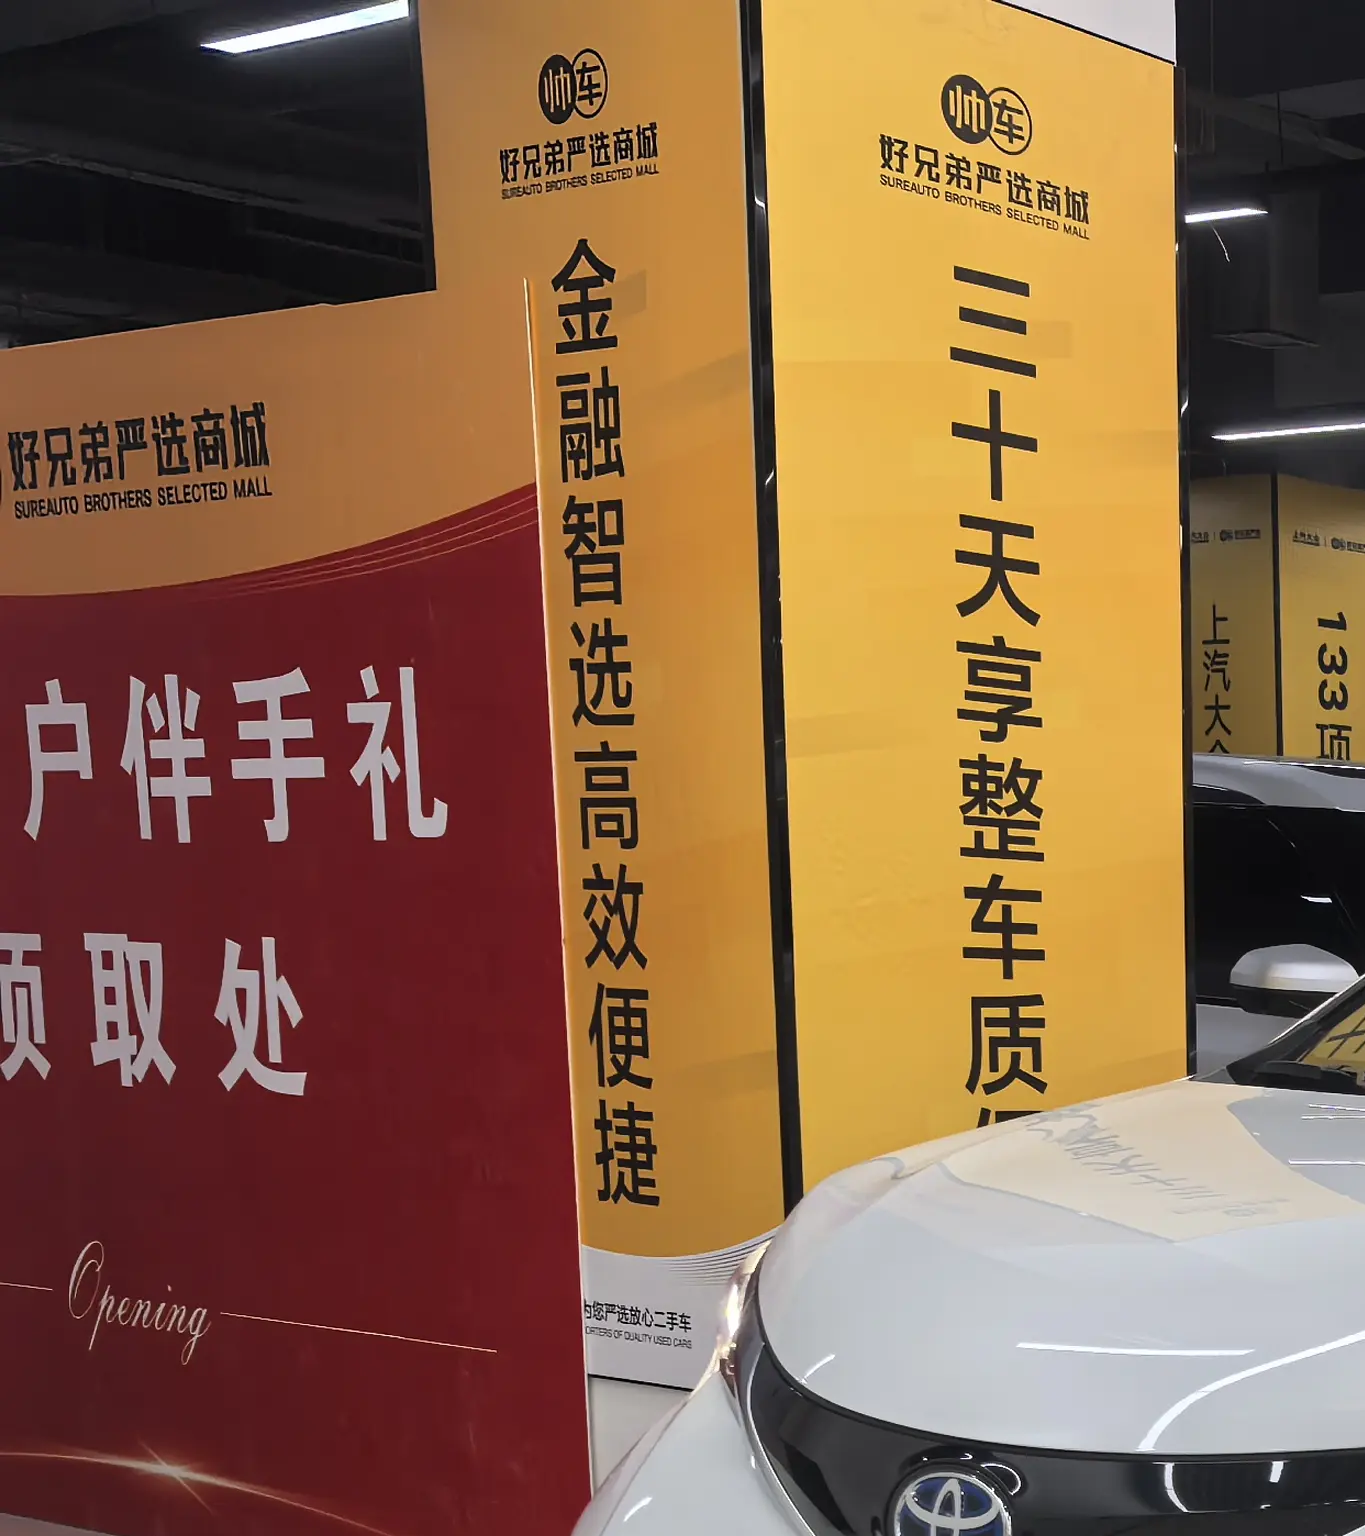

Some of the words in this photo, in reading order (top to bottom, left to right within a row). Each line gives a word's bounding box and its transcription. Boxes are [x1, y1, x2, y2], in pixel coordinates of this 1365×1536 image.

[499, 122, 658, 184] 好兄弟严选商城
[545, 175, 587, 193] BROTHERS
[590, 167, 633, 185] SELECTED
[879, 133, 1090, 225] 好兄弟严选商城
[880, 175, 940, 199] SUREAUTO
[945, 191, 1002, 216] BROTHERS
[1006, 208, 1059, 231] SELECTED
[1063, 223, 1090, 241] MALL
[8, 401, 269, 491] 好兄弟严选商城
[14, 495, 79, 520] SUREAUTO
[85, 489, 152, 513] BROTHERS
[157, 481, 228, 506] SELECTED
[233, 475, 272, 499] MALL
[551, 238, 661, 1208] 金融智选高效便捷
[949, 265, 1049, 1128] 三十天享整车质
[1202, 603, 1232, 753] 上汽大
[24, 666, 448, 843] 户伴手礼
[68, 1241, 212, 1365] Opening
